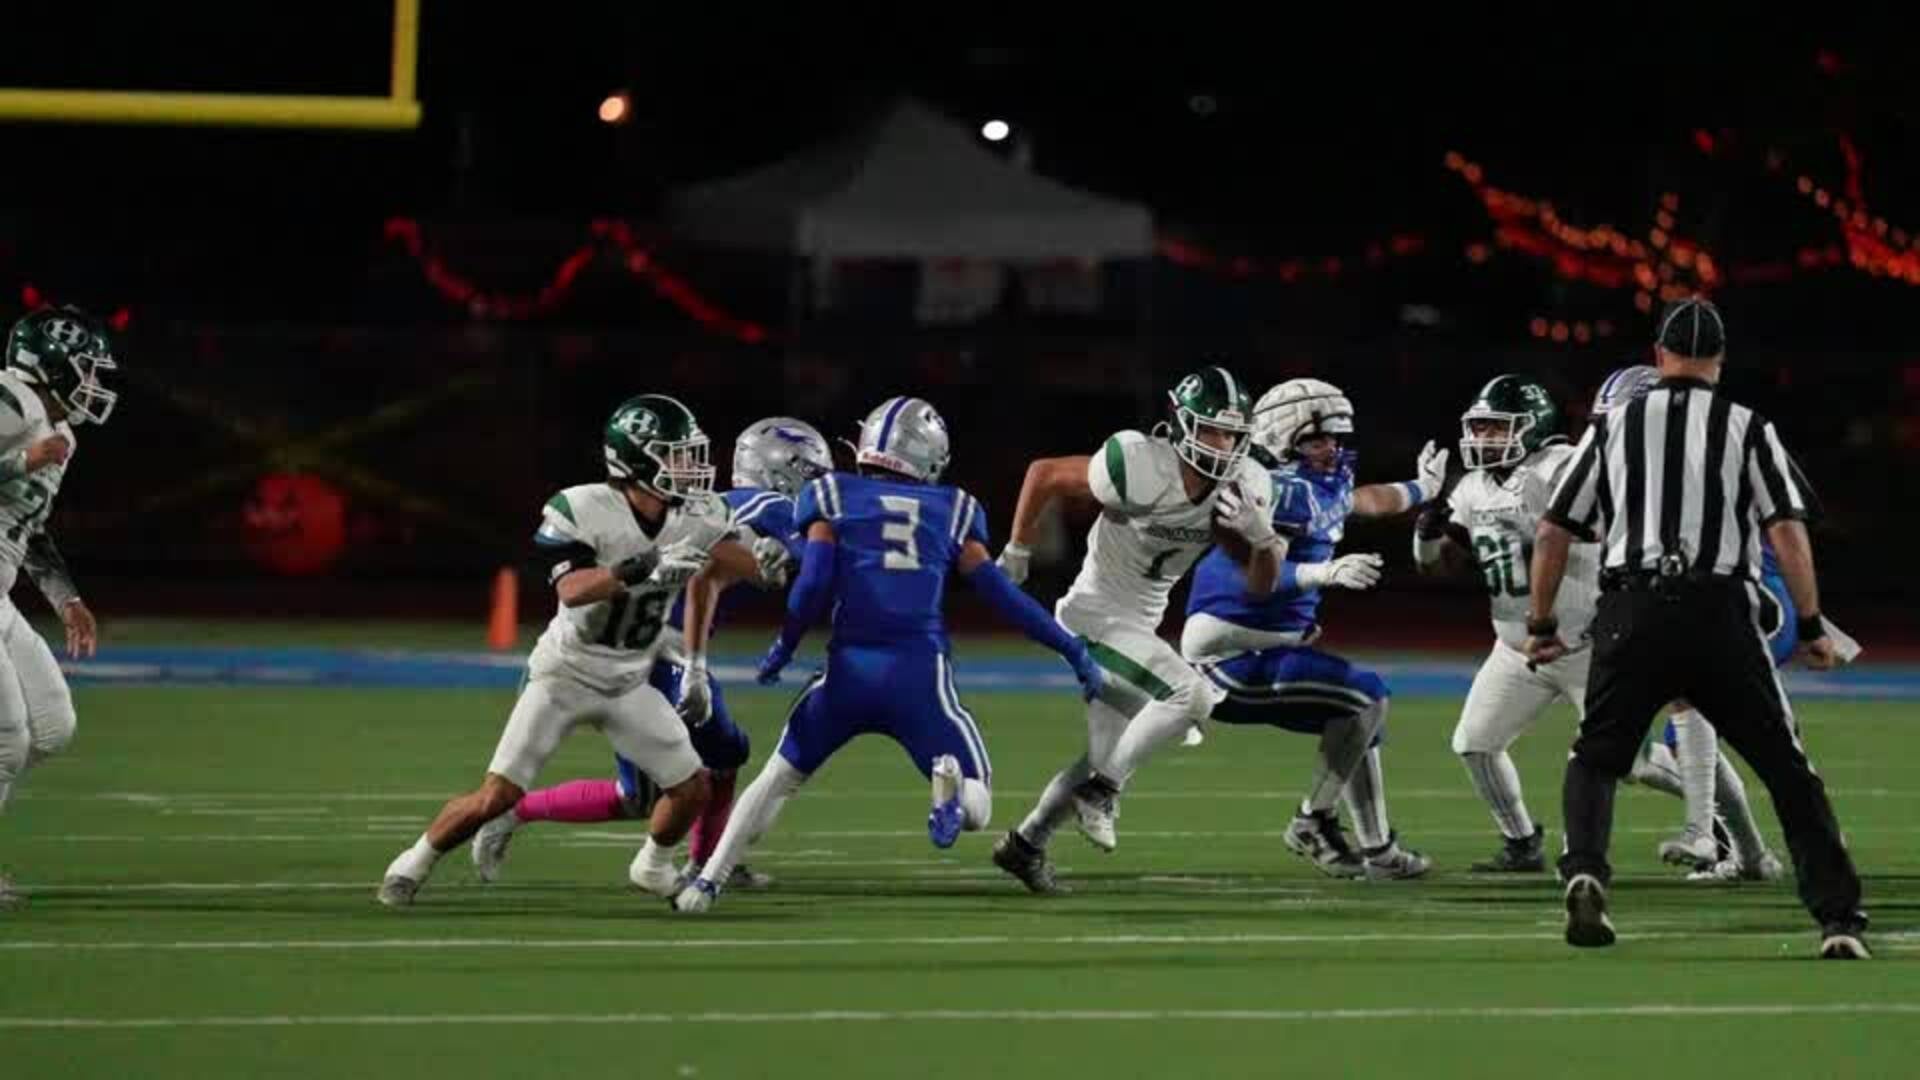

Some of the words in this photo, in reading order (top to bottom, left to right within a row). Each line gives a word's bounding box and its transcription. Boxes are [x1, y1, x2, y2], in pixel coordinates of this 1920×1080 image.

[50, 319, 80, 345] H
[623, 410, 653, 433] H
[880, 495, 920, 569] 3
[1472, 535, 1533, 597] 60
